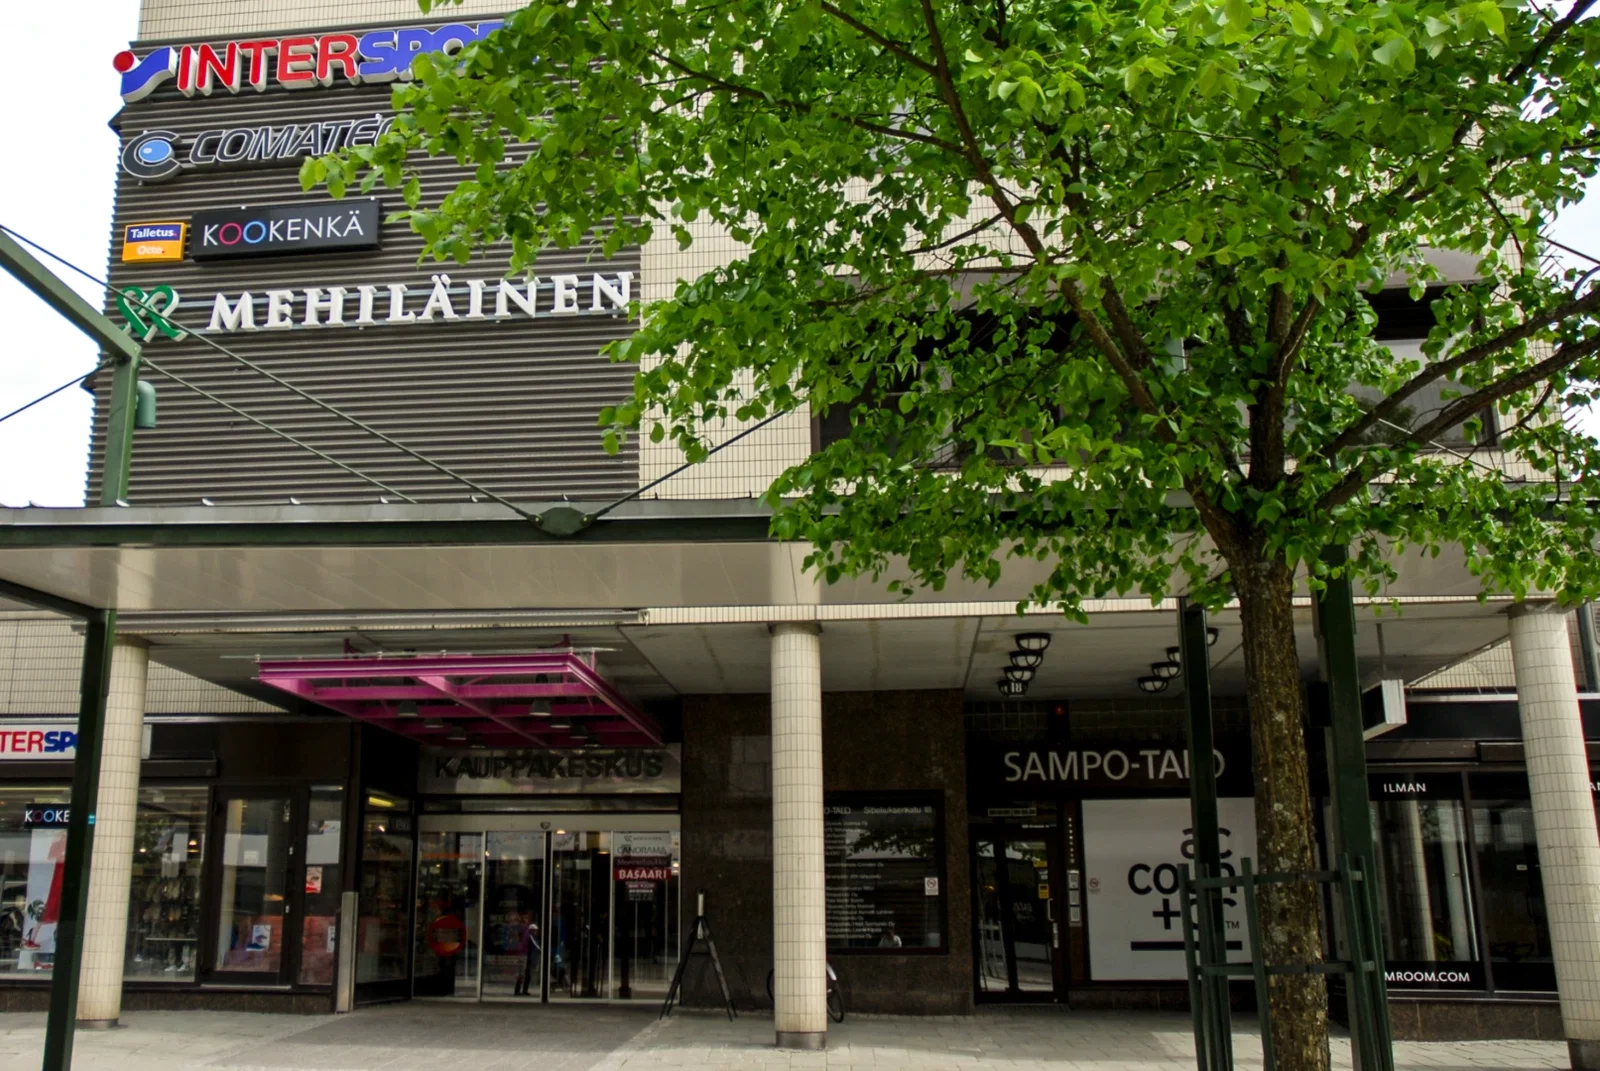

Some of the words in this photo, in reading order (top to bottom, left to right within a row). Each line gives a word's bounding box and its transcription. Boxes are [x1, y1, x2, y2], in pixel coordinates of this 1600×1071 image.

[203, 210, 364, 246] KOOKENKÄ
[206, 271, 633, 332] MEHILÄINEN
[435, 753, 663, 778] KAUPPAKESKUS
[1383, 783, 1427, 793] ILMAN
[618, 869, 667, 880] BASAARI
